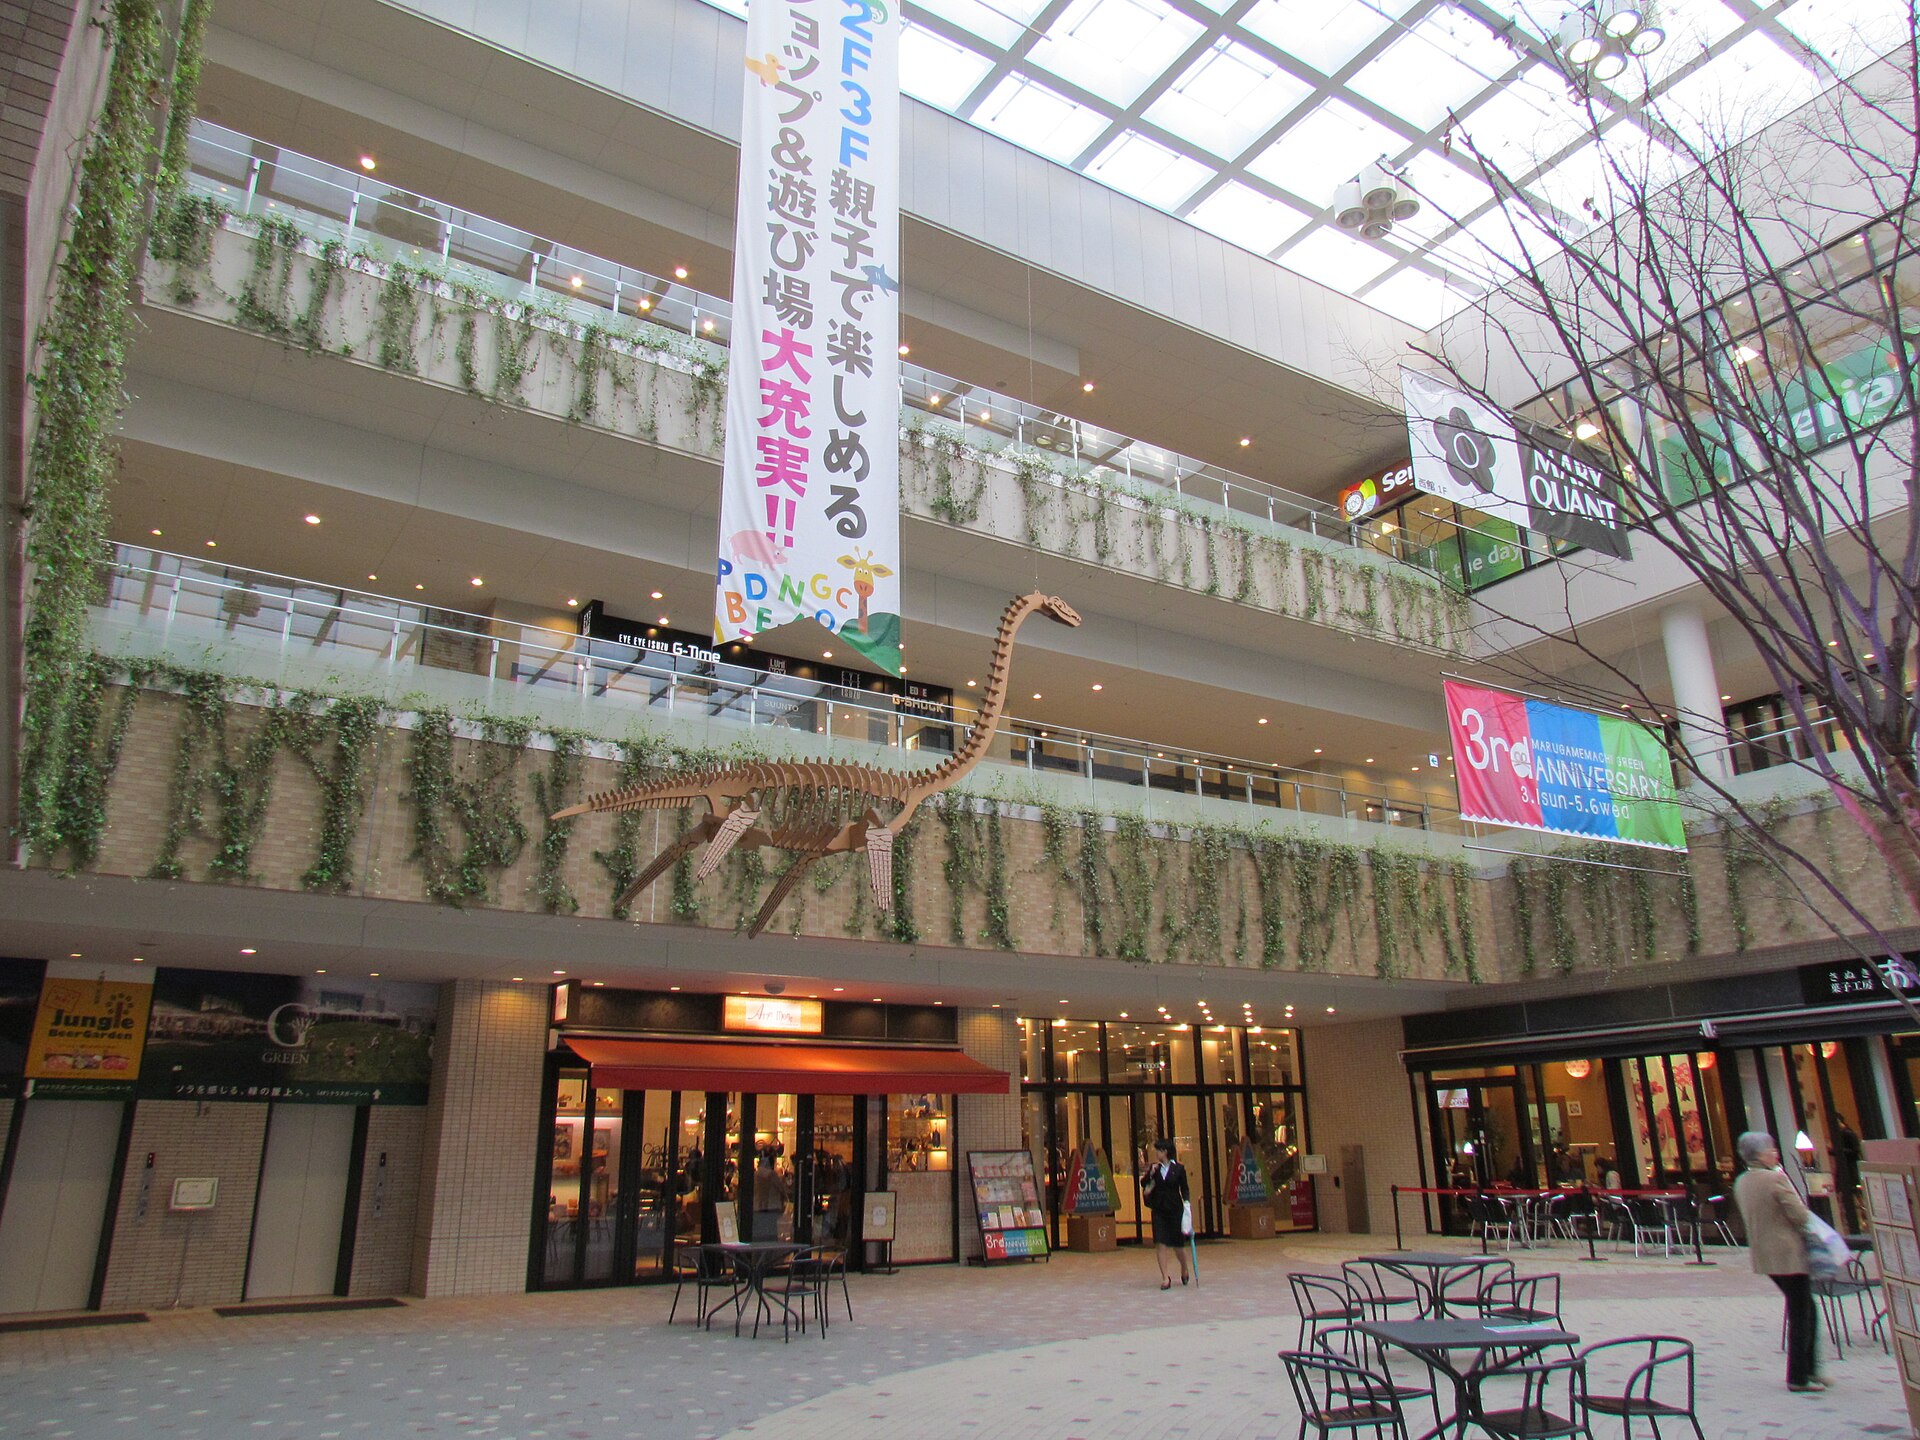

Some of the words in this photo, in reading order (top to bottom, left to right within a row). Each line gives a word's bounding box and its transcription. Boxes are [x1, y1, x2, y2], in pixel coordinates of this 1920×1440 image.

[754, 0, 822, 548] ョップ&遊び場大充実!!
[1529, 475, 1617, 530] QUANT
[619, 634, 632, 645] EYE
[634, 637, 646, 647] EYE
[648, 640, 669, 652] ISUZU
[673, 642, 720, 663] G-Time
[764, 700, 799, 712] SUUNTO
[892, 693, 944, 713] G-SHOCK
[1461, 708, 1533, 779] 3rd
[1618, 757, 1644, 771] GREEN
[51, 1002, 134, 1031] Jungle
[262, 1051, 310, 1064] GREEN
[1078, 1168, 1105, 1192] 3rd
[1238, 1163, 1262, 1185] 3rd
[985, 1234, 1005, 1249] 3rd
